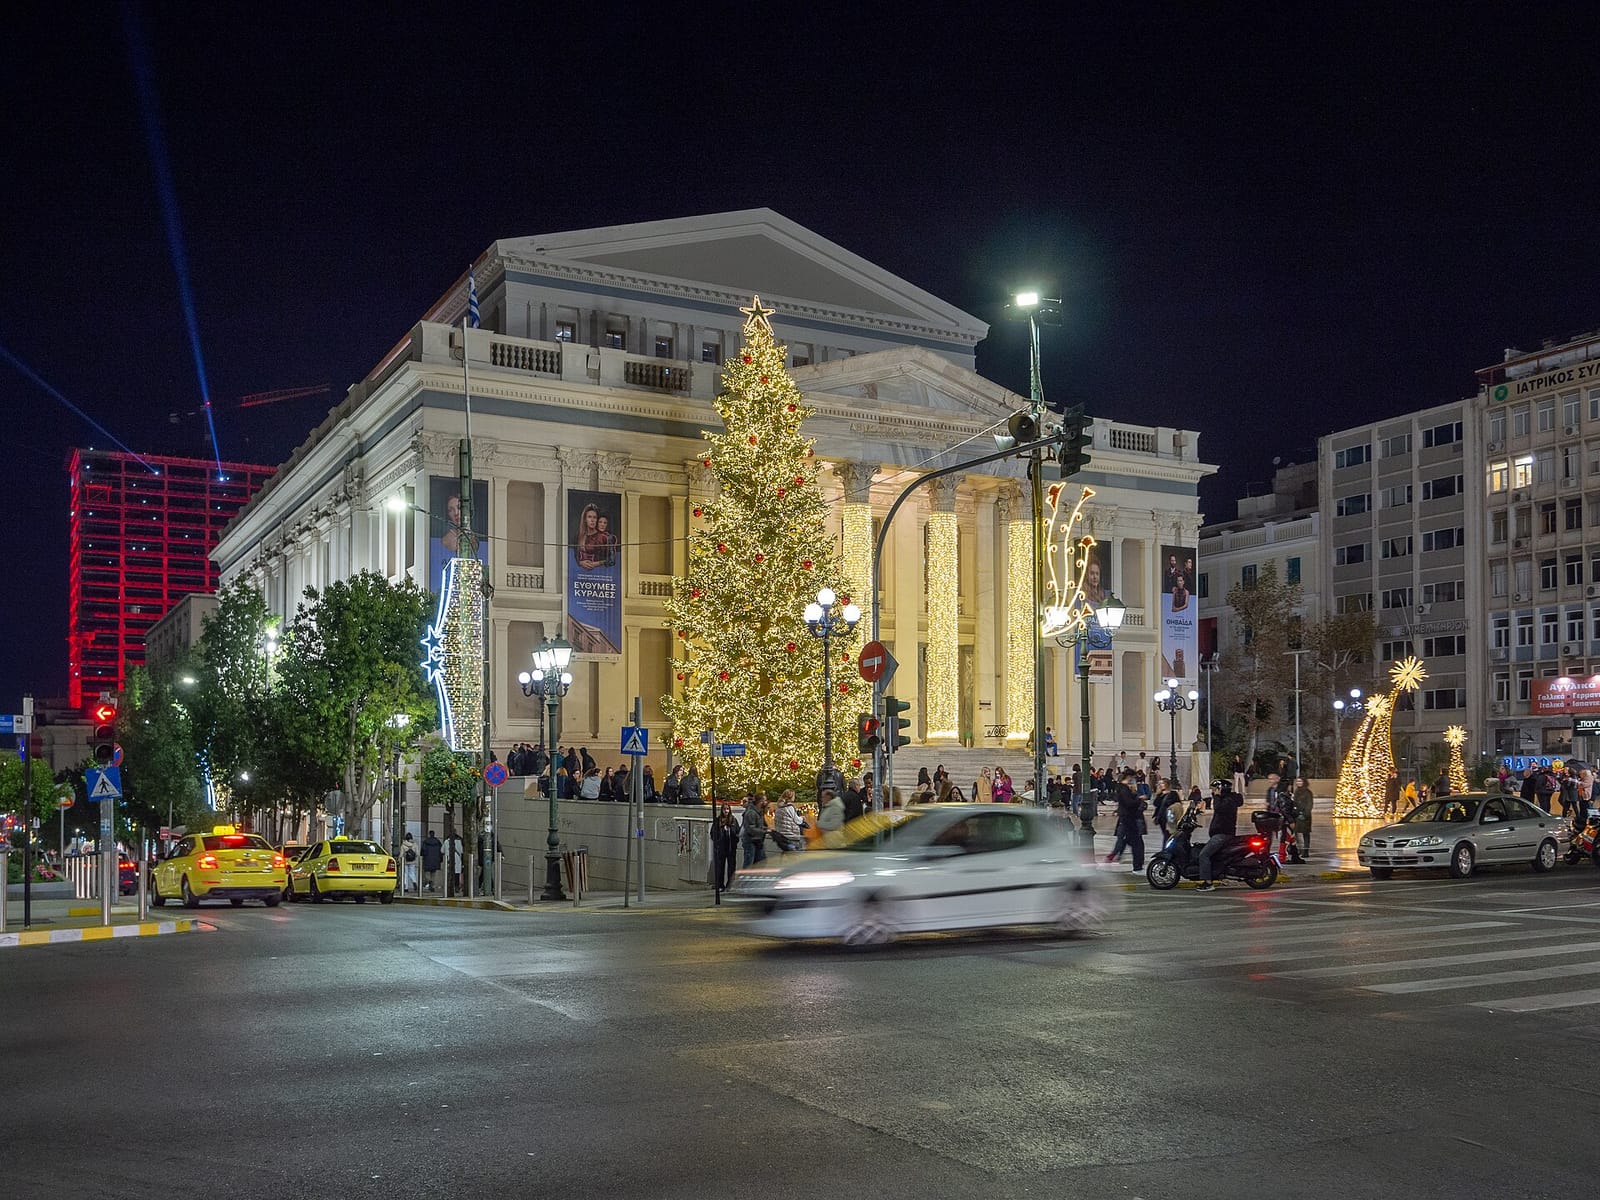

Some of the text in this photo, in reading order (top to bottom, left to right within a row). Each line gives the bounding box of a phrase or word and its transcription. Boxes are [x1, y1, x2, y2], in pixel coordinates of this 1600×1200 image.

[1517, 370, 1574, 394] ΙΑΤΡΙΚΟΣ
[574, 581, 616, 591] ΕΥΘΥΜΕΣ
[574, 589, 616, 599] ΚΥΡΑΔΕΣ
[1549, 682, 1596, 691] Αγγλικά
